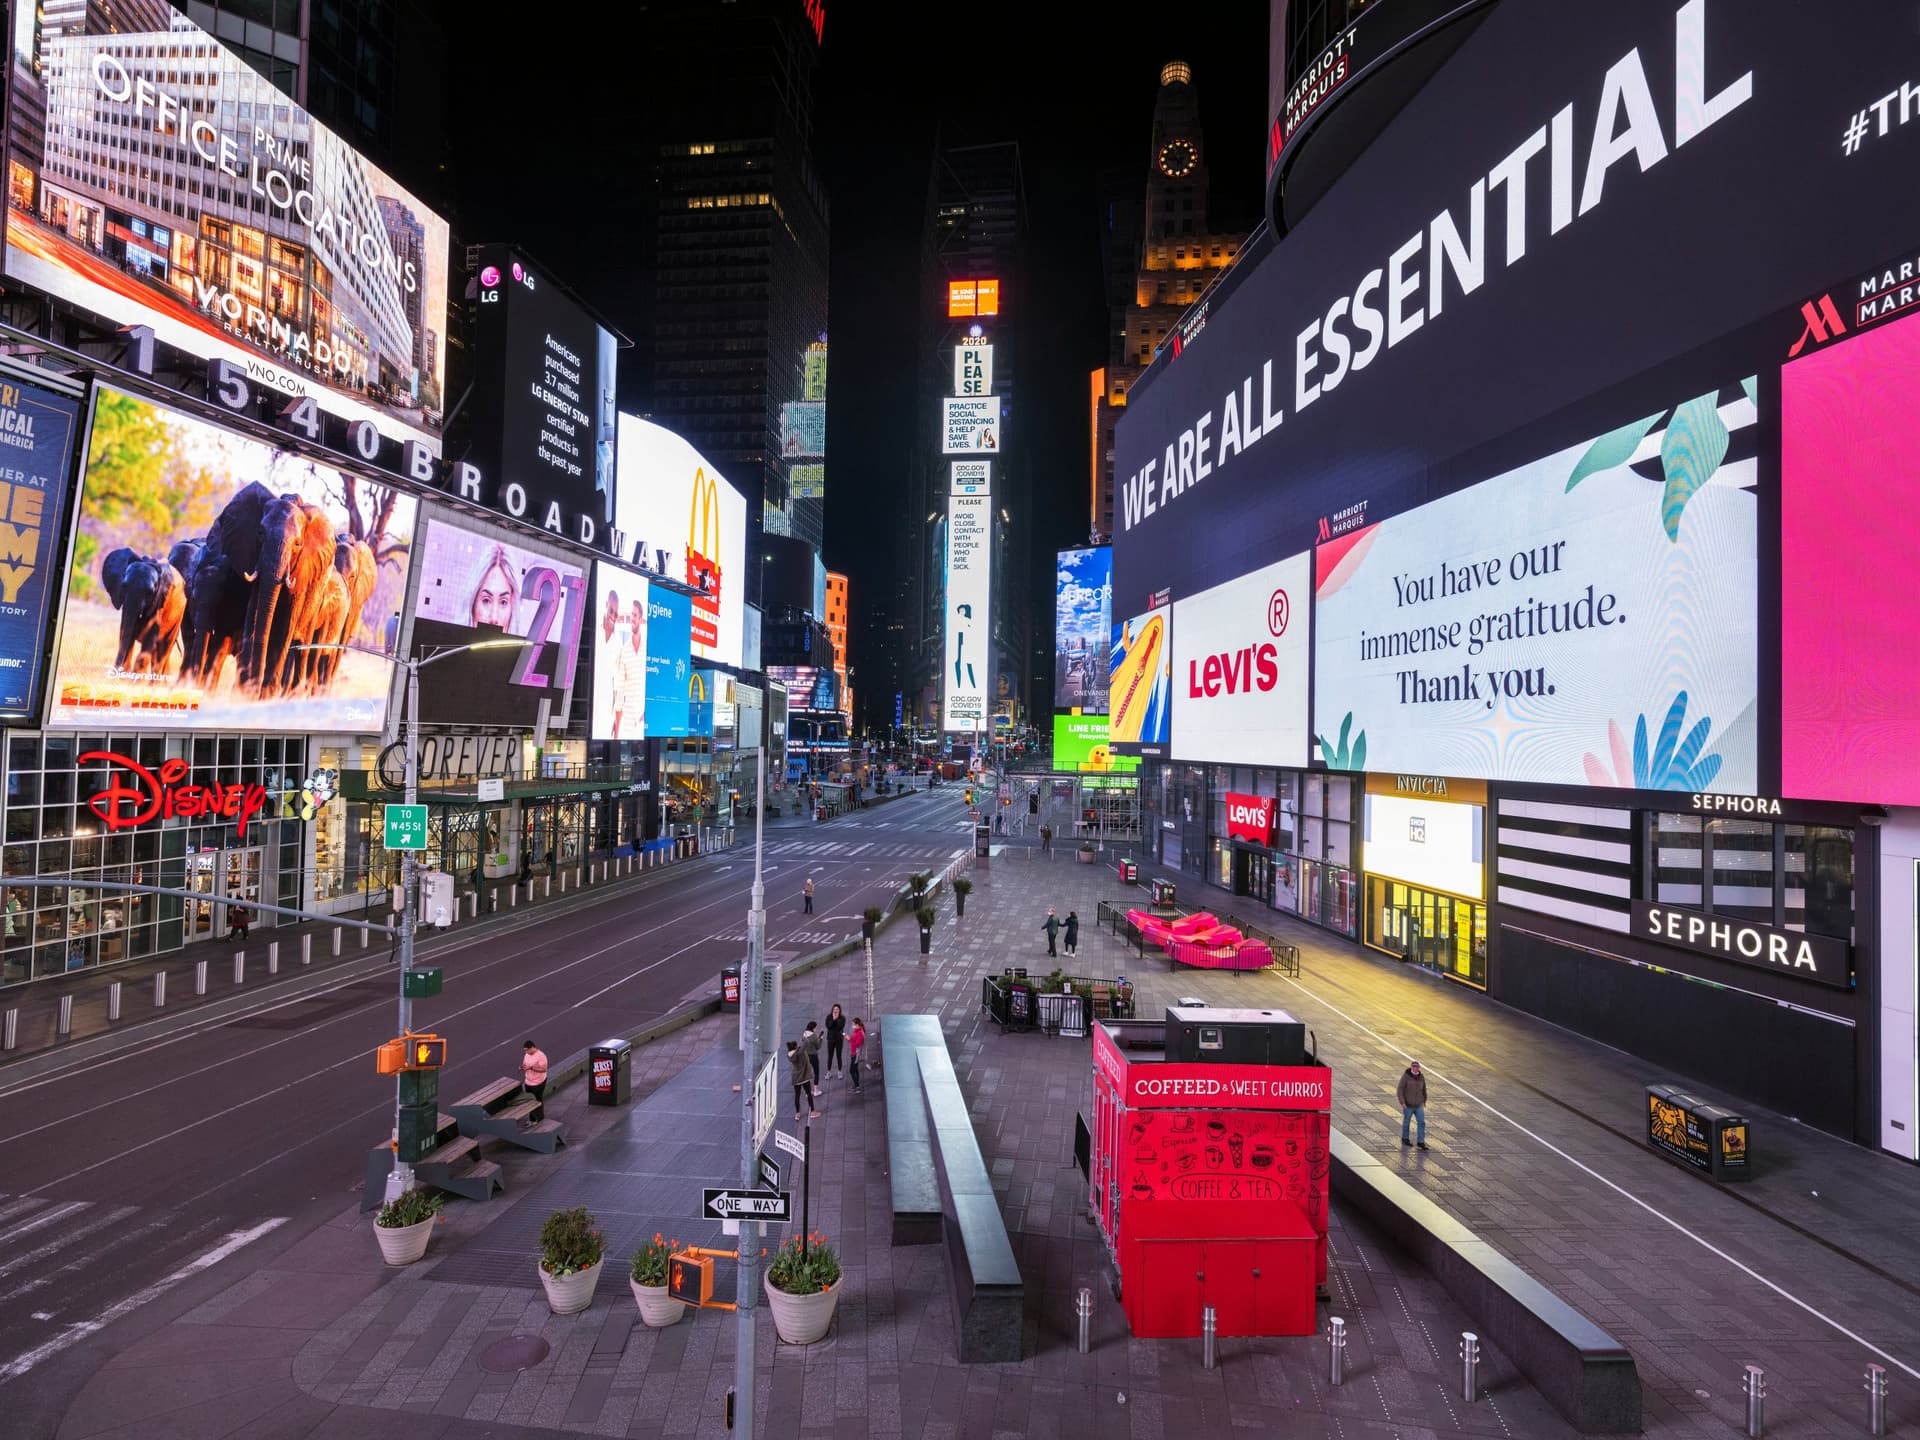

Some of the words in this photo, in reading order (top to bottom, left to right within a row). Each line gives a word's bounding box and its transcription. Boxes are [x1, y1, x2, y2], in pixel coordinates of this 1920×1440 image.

[1286, 28, 1357, 116] MARRIOTT
[1286, 60, 1346, 137] MARQUIS
[255, 126, 311, 182] PRIME
[92, 52, 239, 178] OFFICE
[252, 156, 416, 293] LOCATIONS
[1122, 458, 1157, 531] WE
[1160, 411, 1212, 507] ARE
[1217, 359, 1283, 467] ALL
[1295, 0, 1753, 413] ESSENTIAL
[523, 272, 535, 291] LG
[481, 291, 499, 302] LG
[194, 277, 352, 374] VORNADO
[1183, 302, 1209, 337] MARRIOTT
[962, 336, 987, 346] 2020
[1183, 318, 1206, 349] MARQUIS
[223, 322, 282, 355] REALTY
[283, 351, 332, 378] TRUST
[545, 334, 580, 367] Americans
[964, 351, 982, 363] PL
[247, 359, 306, 397] VNO.COM
[545, 355, 580, 384] purchased
[964, 366, 982, 378] EA
[545, 371, 556, 388] 3.7
[558, 382, 579, 403] million
[963, 380, 982, 393] SE
[532, 382, 542, 398] LG
[543, 389, 572, 416] ENERGY
[572, 408, 589, 427] STAR
[547, 413, 575, 437] certified
[541, 429, 572, 454] products
[572, 443, 579, 457] in
[948, 441, 971, 449] LIVES.
[538, 445, 551, 461] the
[552, 453, 567, 469] past
[568, 464, 582, 476] year
[29, 475, 48, 487] AT
[404, 440, 673, 574] BROADWAY
[1333, 500, 1368, 522] MARRIOTT
[1332, 515, 1364, 535] MARQUIS
[1393, 573, 1434, 608] You
[1440, 557, 1501, 598] have
[1510, 540, 1566, 581] our
[1, 606, 28, 616] TORY
[1361, 619, 1462, 661] immense
[1467, 584, 1626, 655] gratitude.
[508, 566, 586, 689] 21
[1396, 663, 1480, 704] Thank
[1486, 666, 1556, 709] you.
[1068, 724, 1089, 733] LINE
[79, 752, 266, 833] Disney
[1396, 776, 1448, 796] INVICTA
[401, 810, 412, 819] TO
[1692, 794, 1782, 815] SEPHORA
[391, 822, 399, 831] W
[399, 821, 411, 831] 45
[412, 821, 421, 831] St
[1410, 827, 1425, 842] HQ
[1649, 909, 1817, 972] SEPHORA
[724, 978, 739, 987] JERSEY
[593, 1059, 613, 1073] JERSEY
[1097, 1039, 1121, 1083] COFFEED
[595, 1075, 612, 1088] BOYS
[1135, 1079, 1221, 1095] COFFEED
[1230, 1080, 1267, 1096] SWEET
[1271, 1081, 1324, 1098] CHURROS
[1161, 1136, 1198, 1148] Espresso
[1180, 1180, 1222, 1199] COFFEE
[1229, 1179, 1242, 1199] &
[1247, 1180, 1273, 1199] TEA
[717, 1199, 742, 1211] ONE
[753, 1200, 779, 1212] WAY
